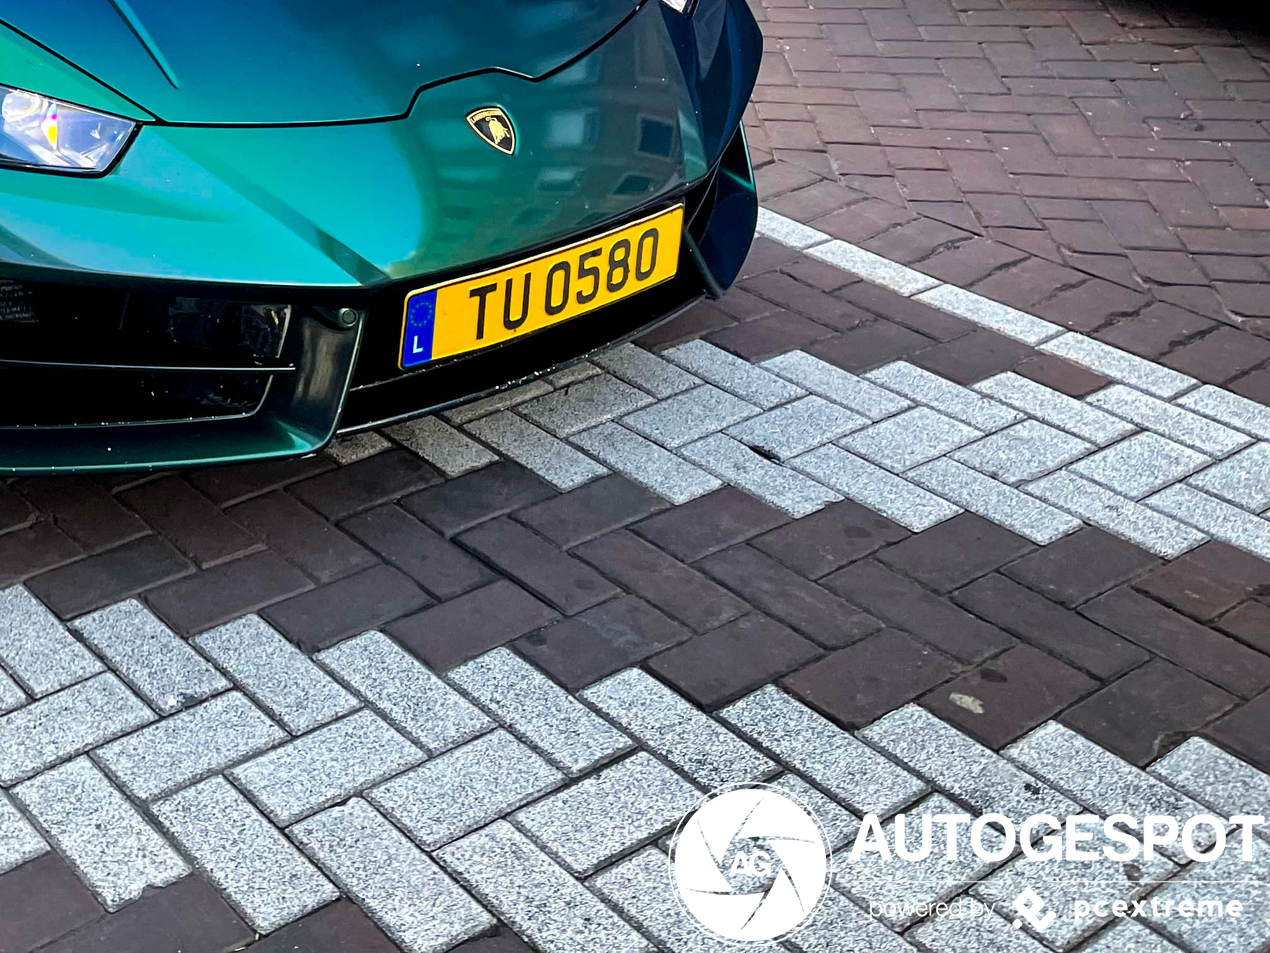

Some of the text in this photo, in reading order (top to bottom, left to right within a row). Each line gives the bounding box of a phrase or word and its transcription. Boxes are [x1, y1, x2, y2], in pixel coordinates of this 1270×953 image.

[469, 227, 659, 341] TU 0580
[412, 335, 424, 354] L
